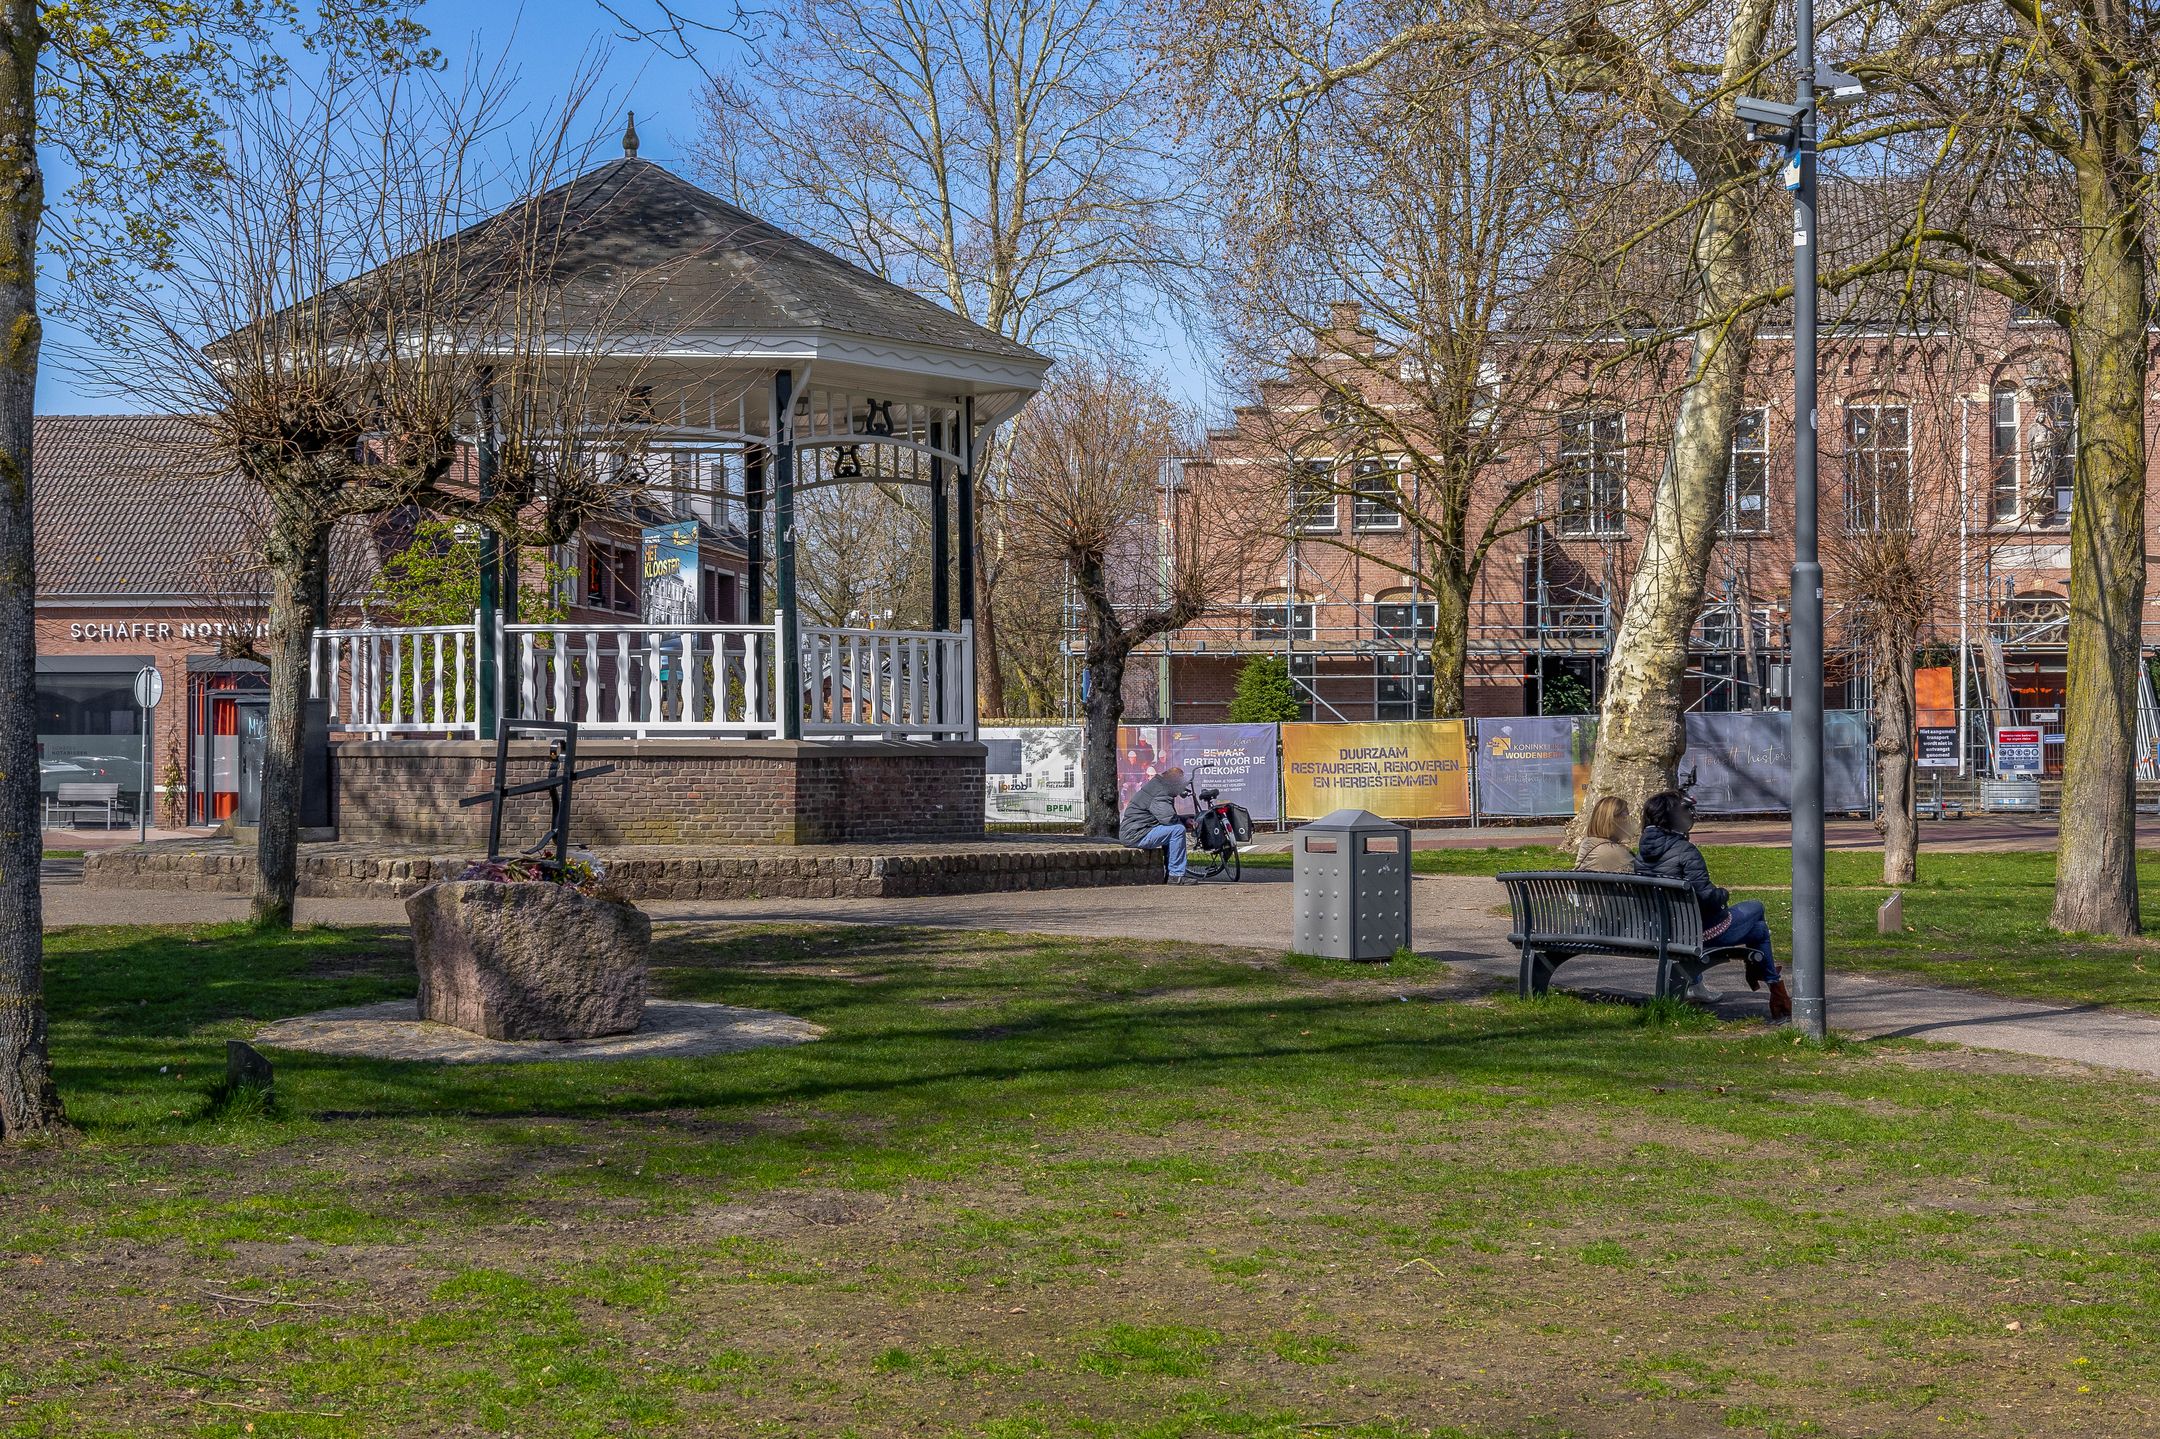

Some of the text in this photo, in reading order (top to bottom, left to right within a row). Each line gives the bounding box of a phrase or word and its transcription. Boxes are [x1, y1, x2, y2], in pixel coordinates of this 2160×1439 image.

[645, 545, 658, 561] HET
[645, 558, 680, 578] KLOOSTER
[70, 621, 170, 638] SCHÄFER
[1339, 747, 1408, 760] DUURZAAM
[1183, 756, 1266, 767] FORTEN VOOR DE
[1291, 760, 1459, 775] RESTAUREREN, RENOVEREN
[1199, 766, 1251, 776] TOEKOMST
[1313, 775, 1438, 788] EN HERBESTEMMEN
[1046, 804, 1072, 812] BPEM
